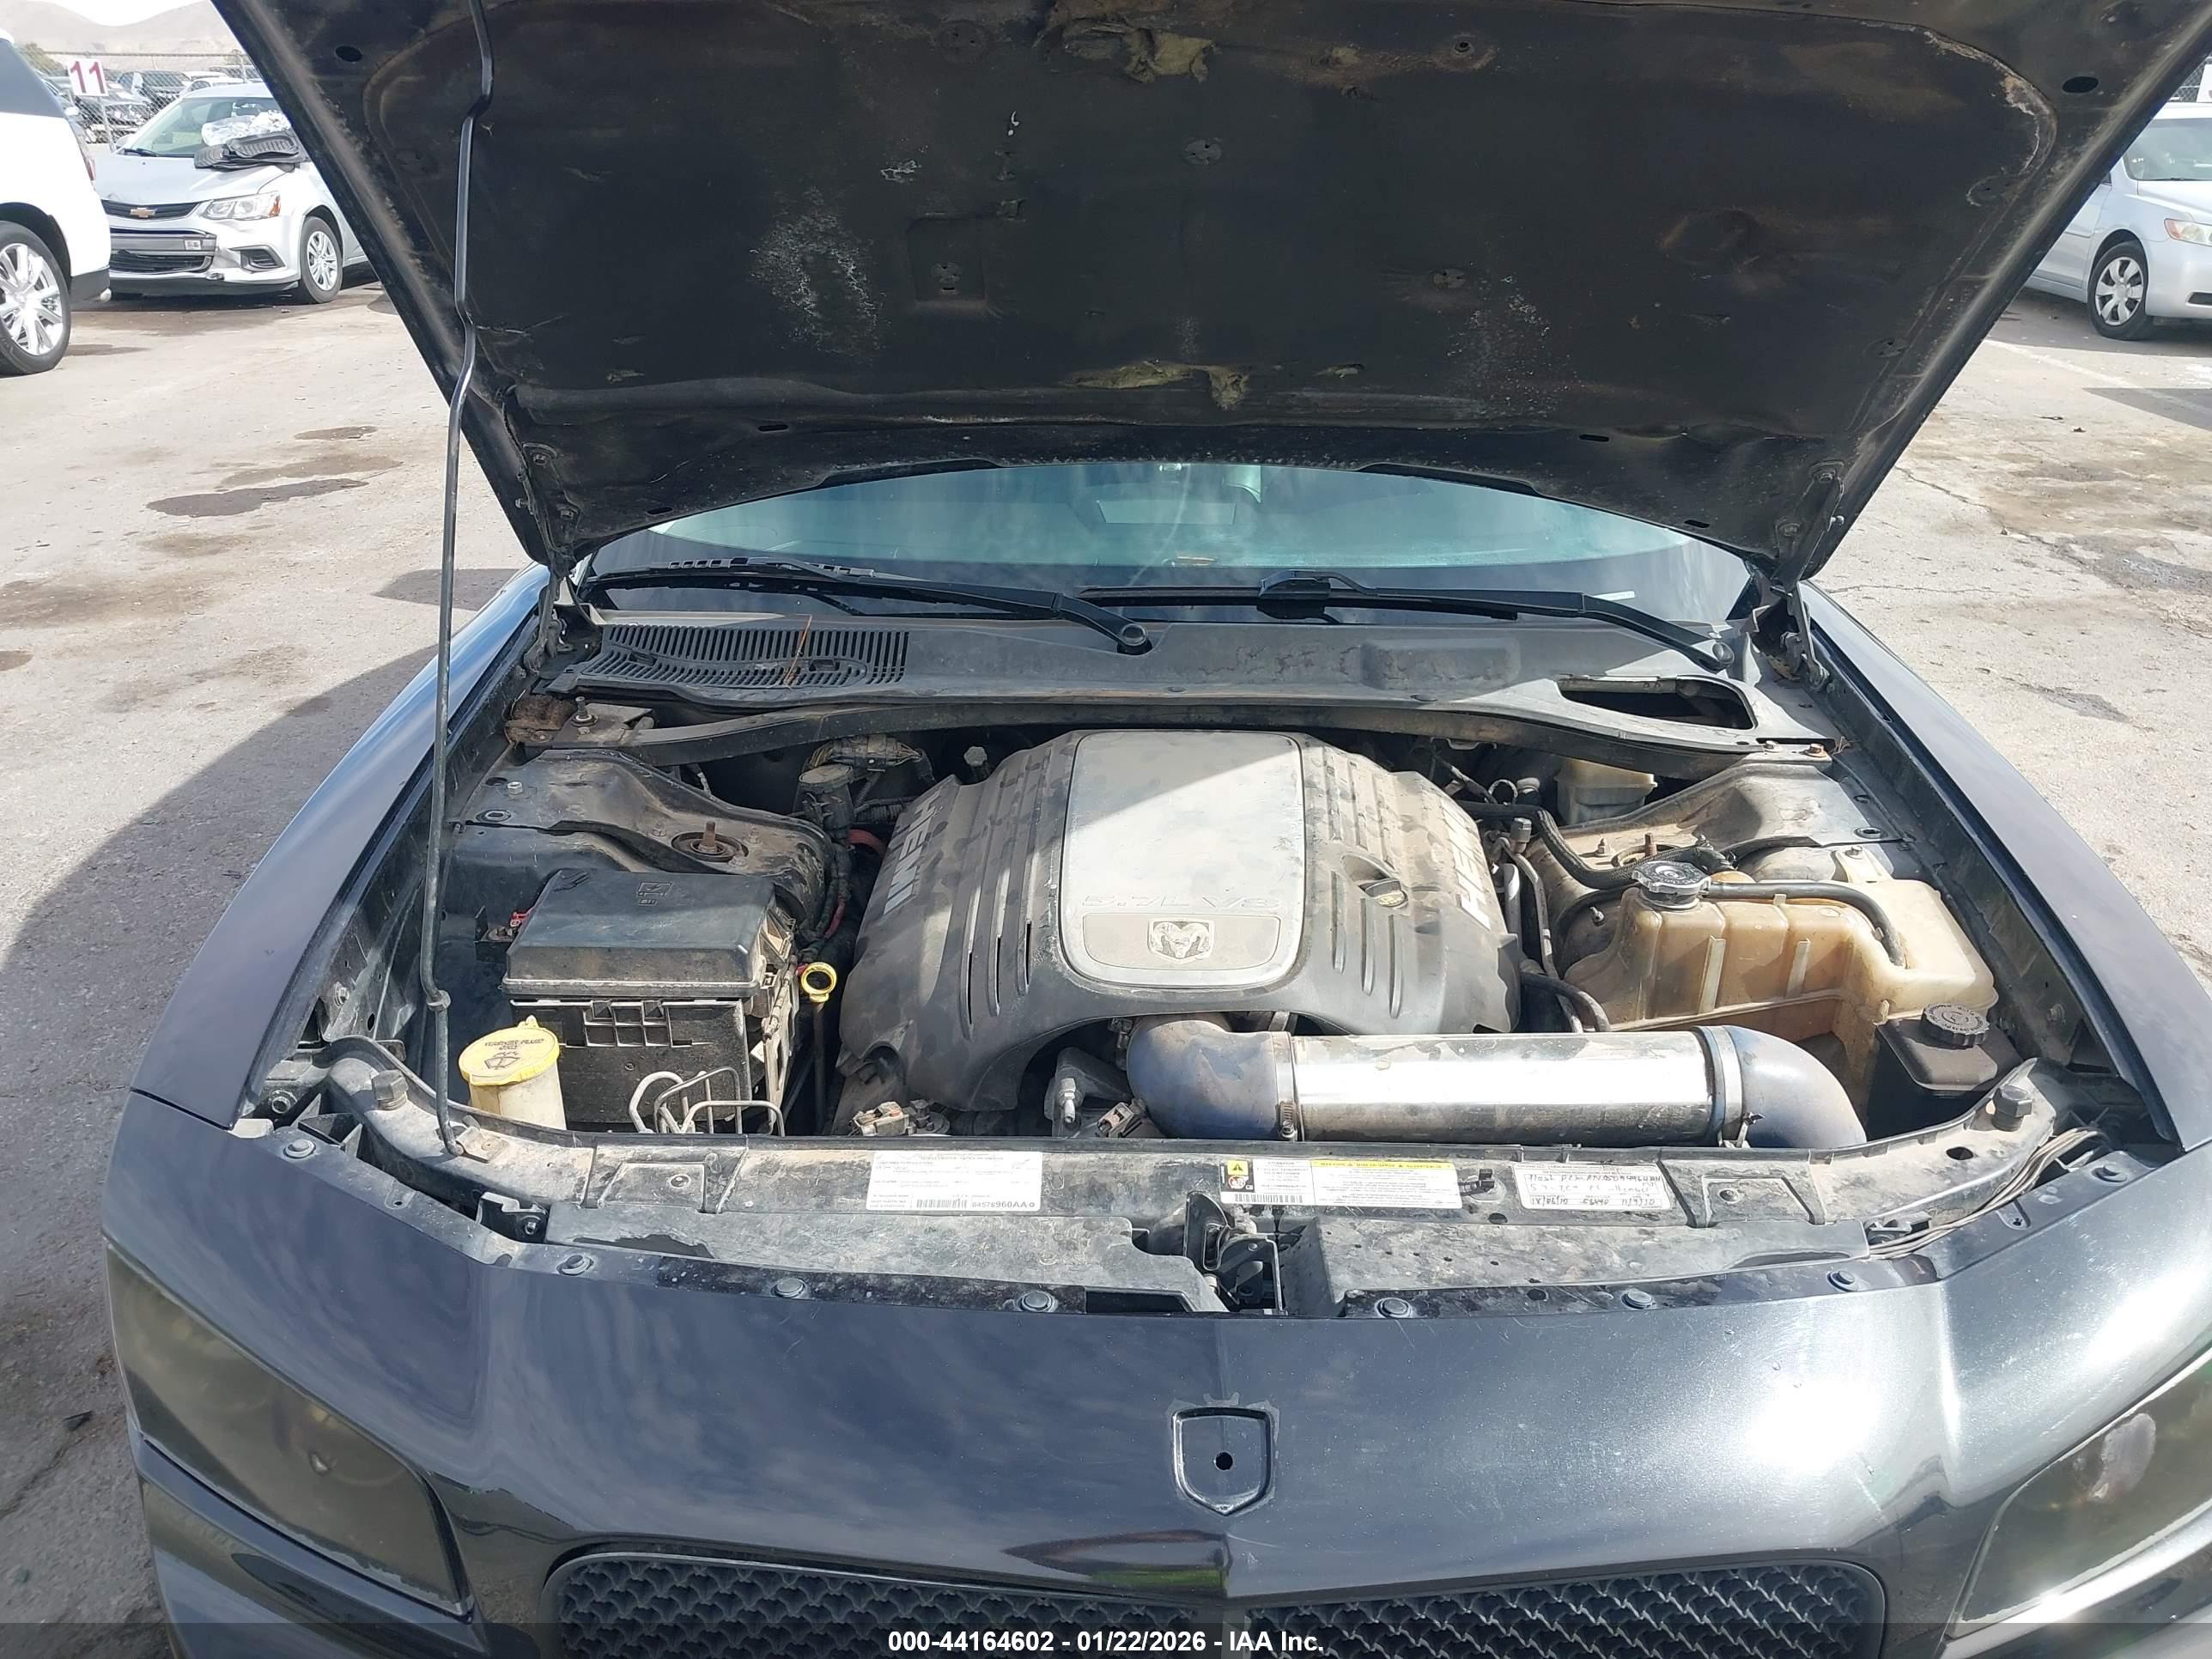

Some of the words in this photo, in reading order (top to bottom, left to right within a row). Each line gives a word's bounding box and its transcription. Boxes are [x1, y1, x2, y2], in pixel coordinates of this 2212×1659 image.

[70, 60, 106, 94] 11
[884, 787, 942, 915] HEMI
[1440, 798, 1491, 930] HEMI
[1082, 894, 1191, 908] 5.7L
[1202, 895, 1281, 908] V8
